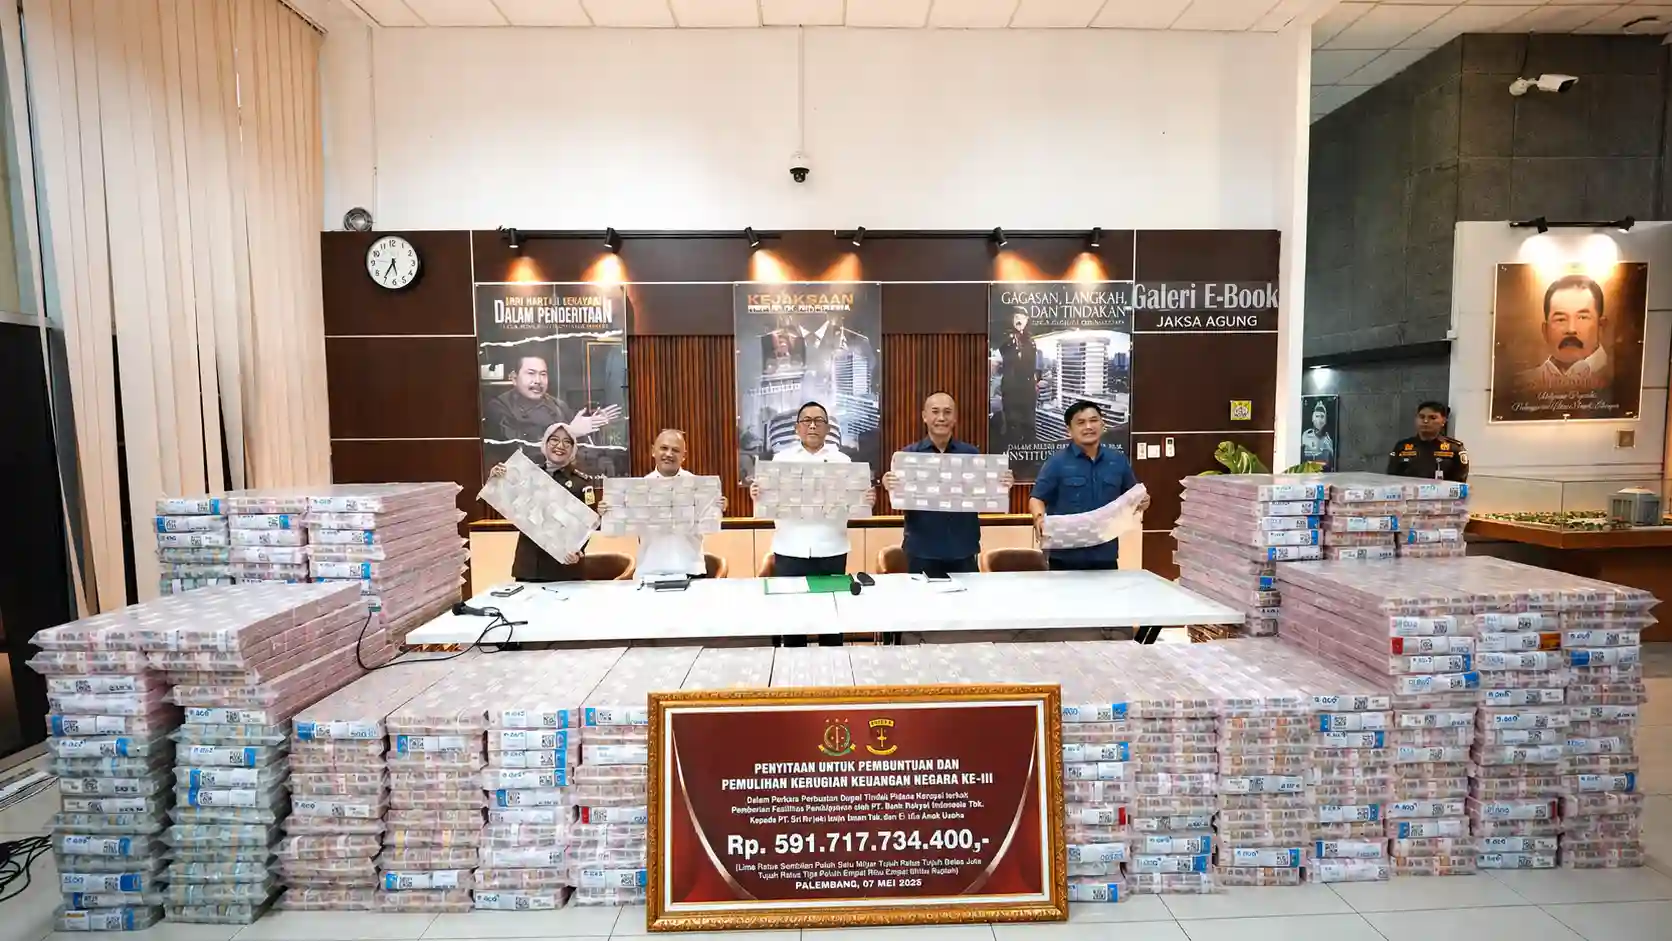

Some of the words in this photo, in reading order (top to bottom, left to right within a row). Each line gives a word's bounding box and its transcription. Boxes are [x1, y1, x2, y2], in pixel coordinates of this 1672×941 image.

[748, 293, 854, 305] KEJAKSAAN
[1002, 292, 1062, 304] GAGASAN,
[1066, 292, 1127, 304] LANGKAH,
[1132, 283, 1196, 310] Galeri
[1204, 282, 1278, 309] E-Book
[494, 299, 534, 324] DALAM
[538, 297, 612, 324] PENDERITAAN
[1031, 306, 1058, 318] DAN
[1060, 306, 1126, 318] TINDAKAN
[1156, 316, 1202, 328] JAKSA
[1206, 316, 1258, 327] AGUNG
[754, 762, 816, 774] PENYITAAN
[818, 761, 856, 772] UNTUK
[858, 760, 934, 772] PEMBUNTUAN
[936, 758, 960, 770] DAN
[722, 778, 788, 790] PEMULIHAN
[790, 776, 848, 788] KERUGIAN
[851, 775, 910, 787] KEUANGAN
[914, 773, 958, 786] NEGARA
[961, 772, 994, 784] KE-III
[727, 834, 766, 860] Rp.
[774, 828, 990, 854] 591.717.734.400,-
[796, 880, 860, 890] PALEMBANG,
[862, 880, 875, 888] 07
[877, 878, 896, 888] MEI
